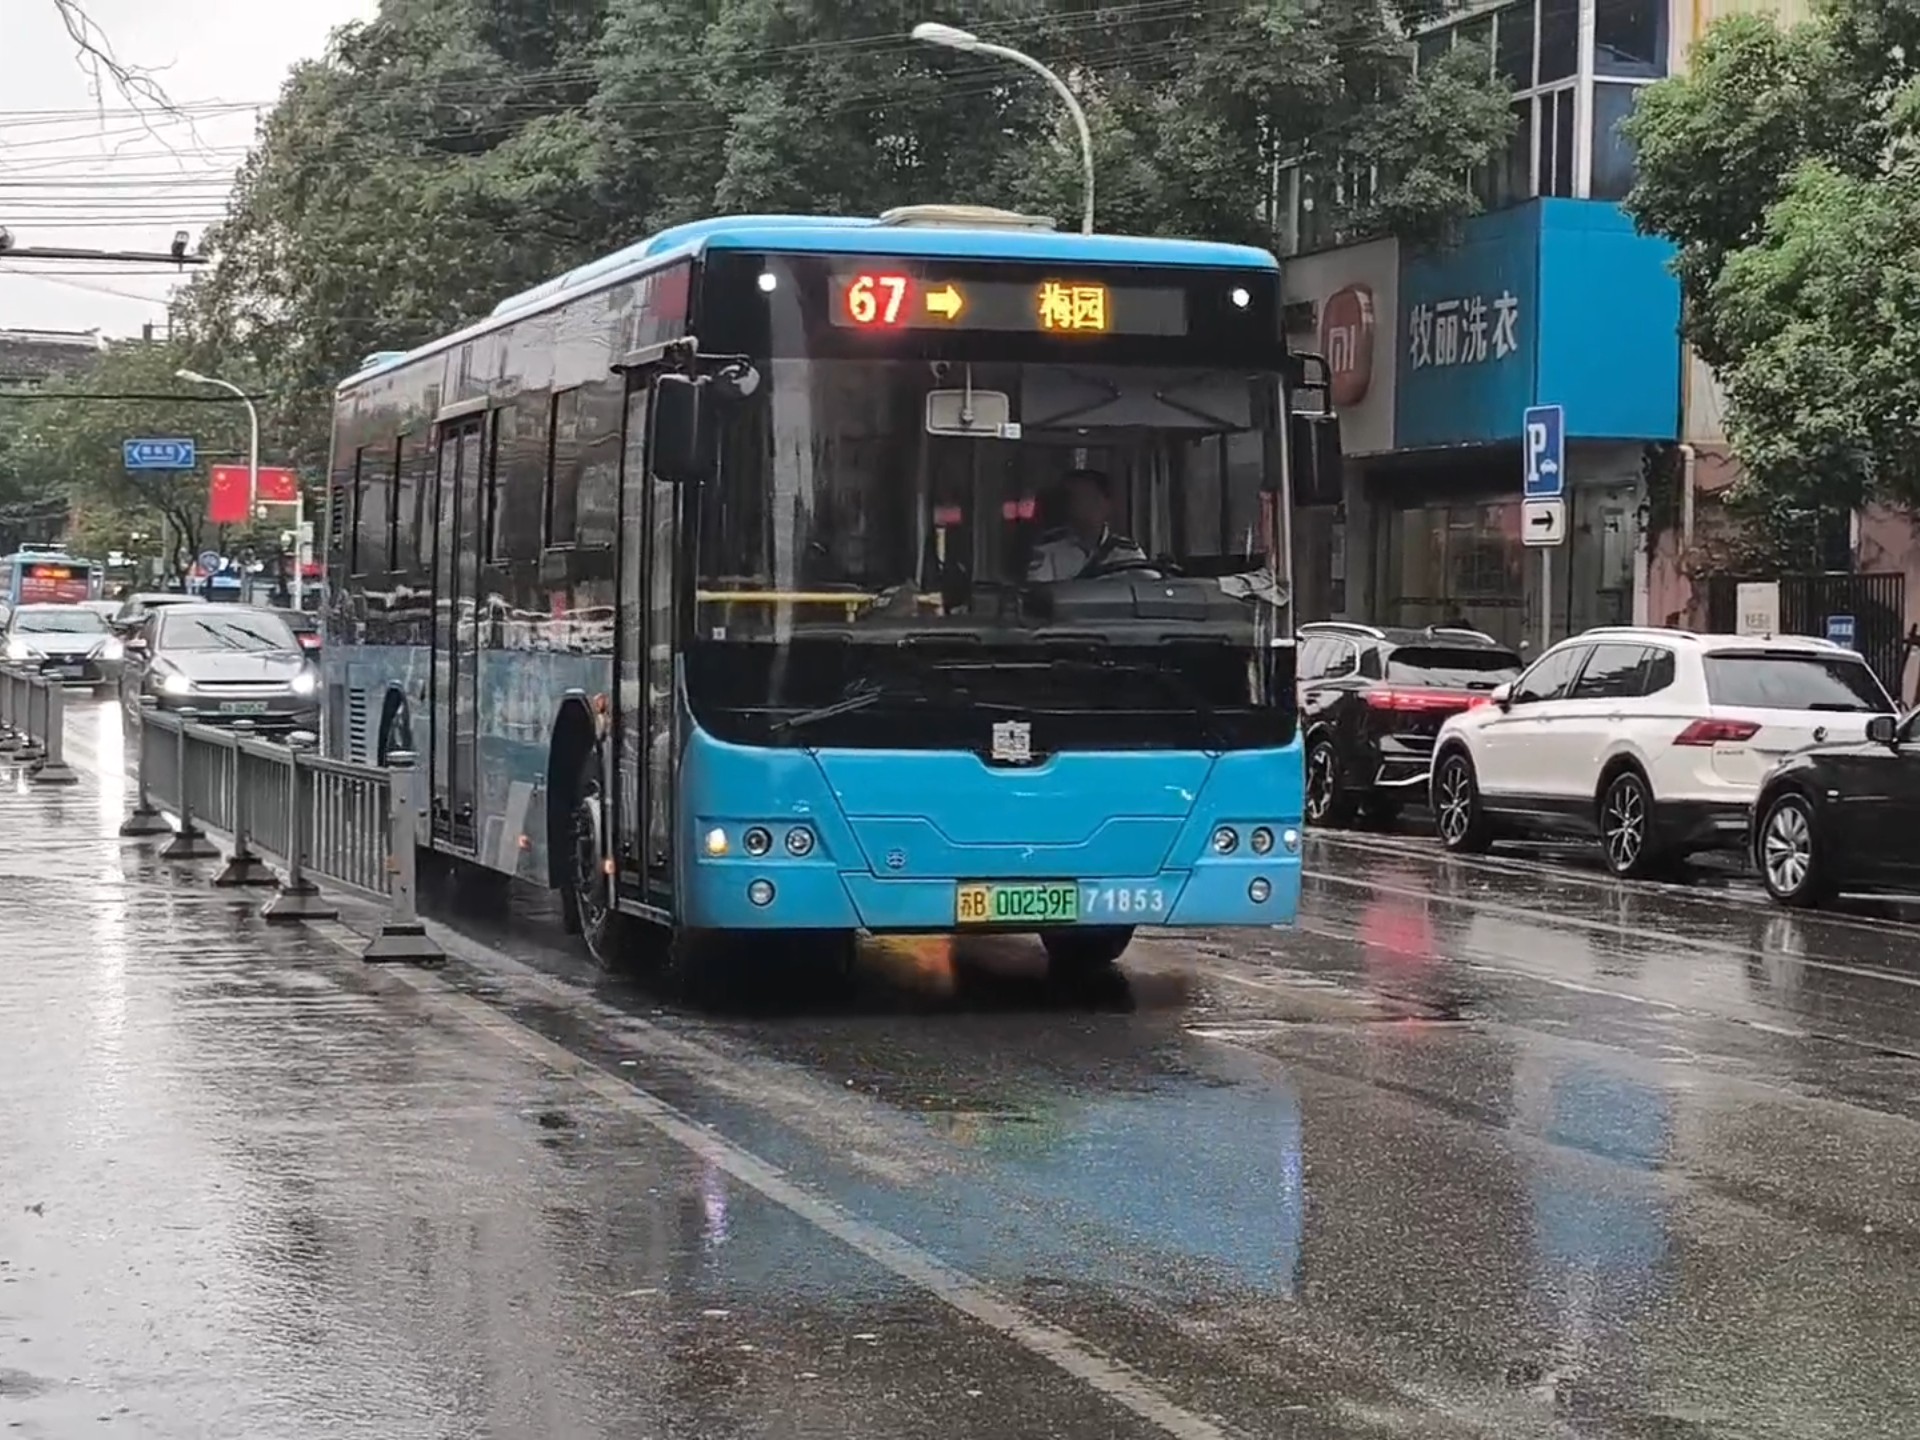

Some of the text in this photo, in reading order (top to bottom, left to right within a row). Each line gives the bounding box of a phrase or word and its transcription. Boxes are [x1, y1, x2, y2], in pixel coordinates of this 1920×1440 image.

[849, 276, 907, 323] 67
[1039, 282, 1105, 329] 梅园
[1528, 423, 1547, 481] P
[996, 889, 1075, 917] 00259F
[1085, 889, 1164, 912] 71853
